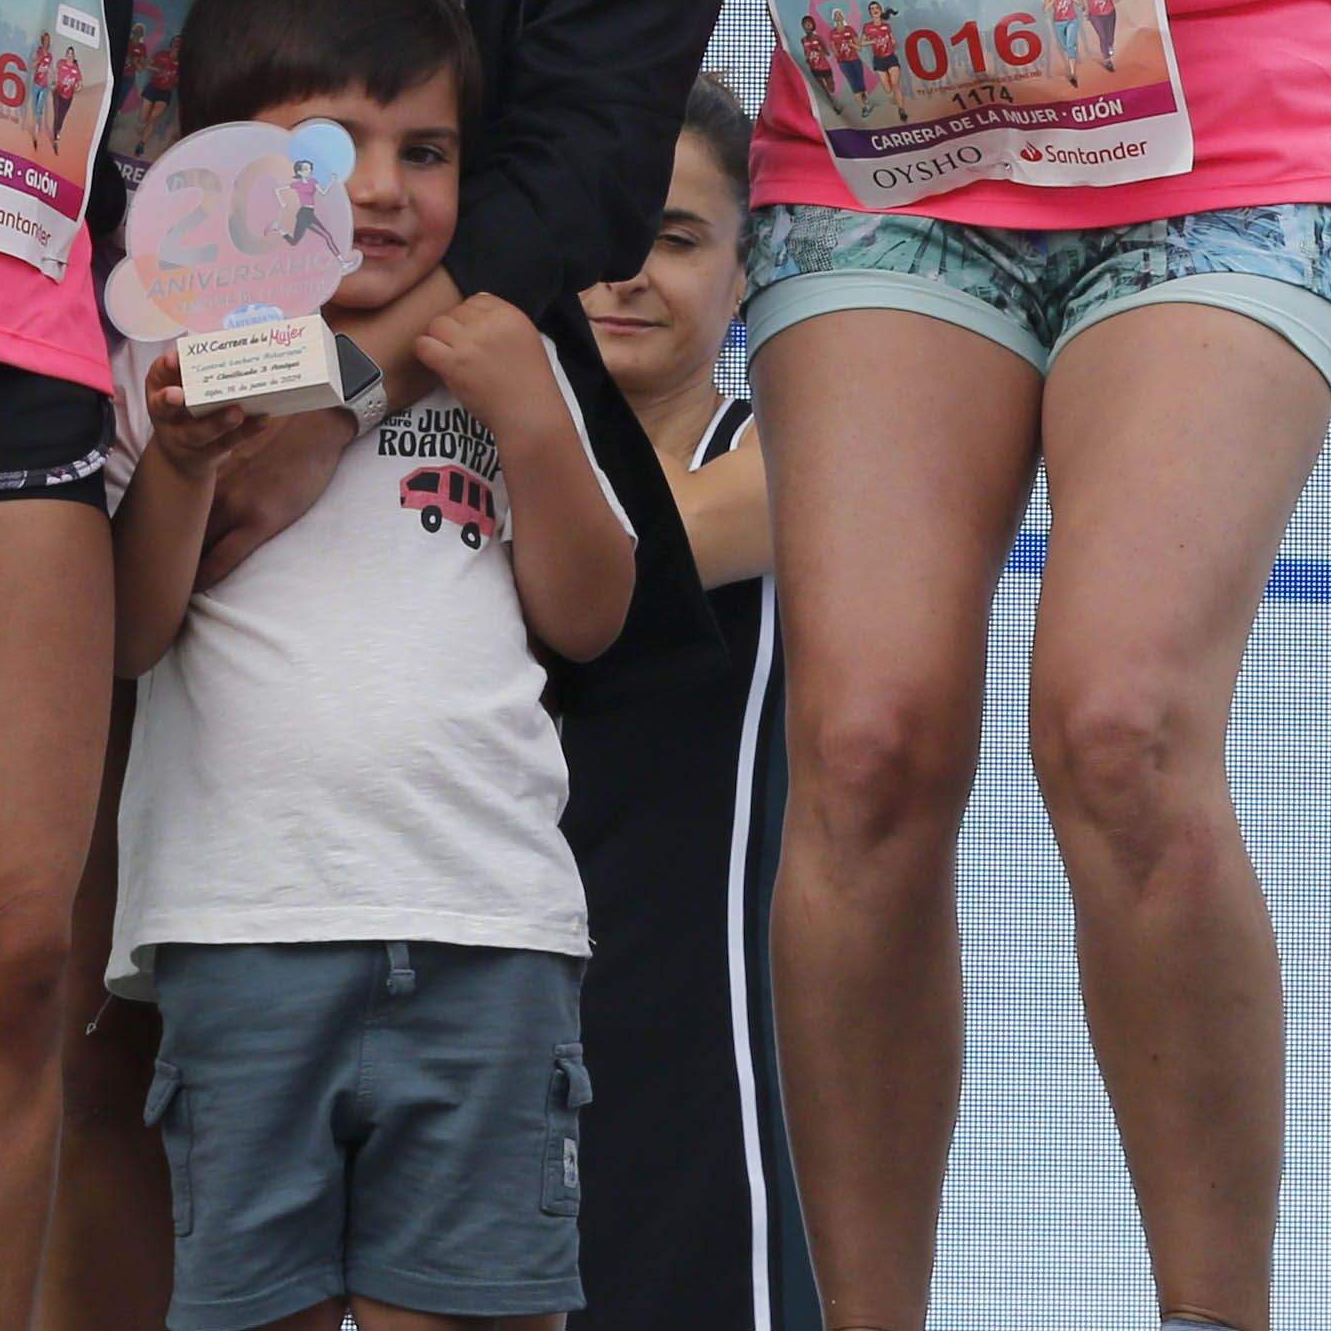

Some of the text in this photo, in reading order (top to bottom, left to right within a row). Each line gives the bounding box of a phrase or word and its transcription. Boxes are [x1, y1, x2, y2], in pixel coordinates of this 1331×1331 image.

[904, 12, 1043, 81] 016
[952, 85, 1014, 110] 1174
[871, 97, 1124, 151] CARRERA DE LA MUJER GIJÓN
[25, 172, 59, 198] GIJÓN
[872, 140, 1148, 189] OYSHO Santander
[159, 152, 301, 271] 20
[187, 341, 209, 356] XIX
[209, 338, 249, 352] Carrera
[250, 335, 259, 344] de
[268, 324, 305, 347] Mujer
